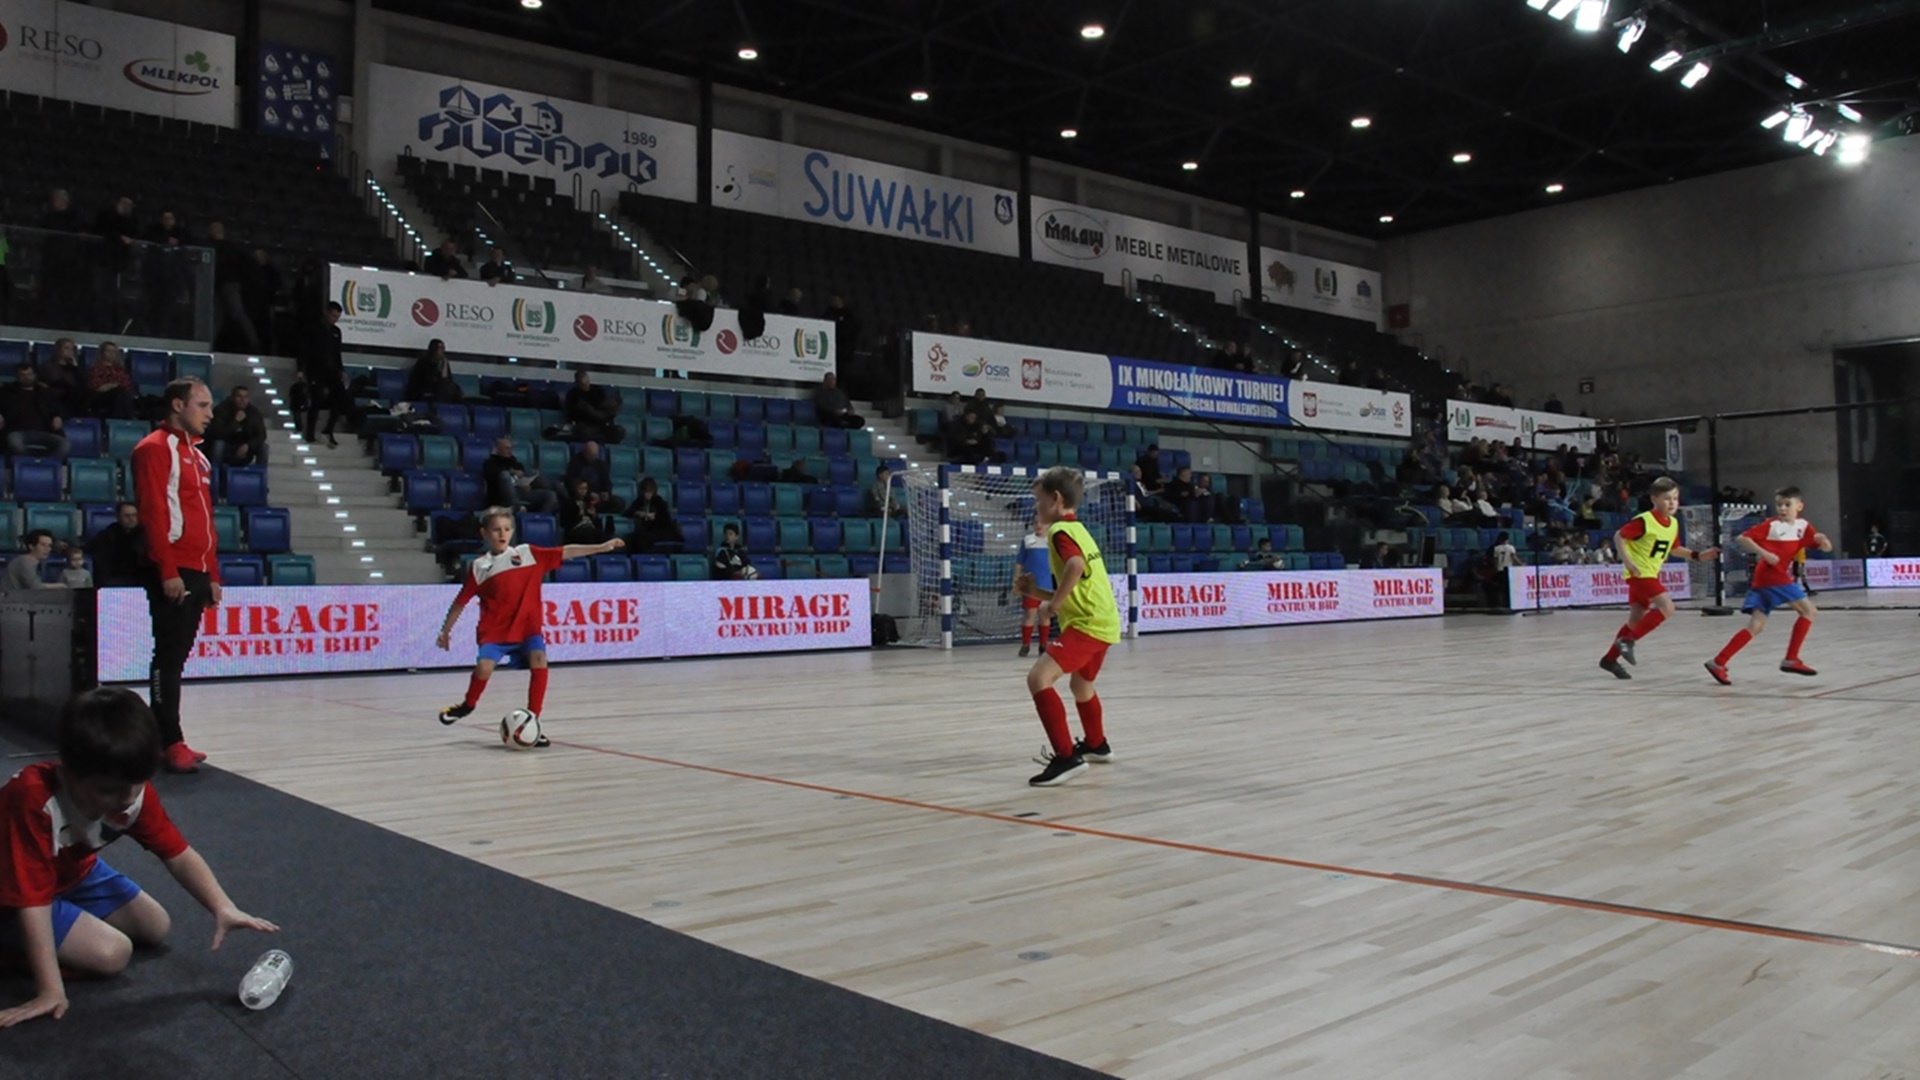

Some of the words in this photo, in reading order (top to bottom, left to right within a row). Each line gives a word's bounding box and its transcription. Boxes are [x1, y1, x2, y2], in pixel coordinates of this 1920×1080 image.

[19, 25, 103, 61] RESO
[140, 64, 220, 89] MLEKPOL
[622, 130, 657, 149] 1989
[803, 152, 974, 244] SUWAŁKI
[1115, 235, 1164, 261] MEBLE
[1167, 247, 1241, 276] METALOWE
[445, 303, 495, 322] RESO
[603, 318, 647, 337] RESO
[1117, 365, 1133, 387] IX
[1135, 367, 1234, 397] MIKOŁAJKOWY
[1236, 379, 1284, 403] TURNIEJ
[1267, 580, 1339, 601] MIRAGE
[1373, 578, 1434, 597] MIRAGE
[1526, 574, 1571, 590] MRAGE
[1141, 583, 1227, 606] MIRAGE
[1373, 596, 1415, 609] CENTRUM
[717, 593, 851, 620] MIRAGE
[1141, 606, 1199, 619] CENTRUM
[1202, 605, 1227, 617] BHP
[1266, 601, 1316, 613] CENTRUM
[1318, 600, 1340, 611] BHP
[594, 627, 640, 644] BHP
[717, 622, 810, 640] CENTRUM
[813, 619, 851, 637] BHP
[189, 636, 315, 658] ENTRUM
[323, 635, 380, 654] BHP
